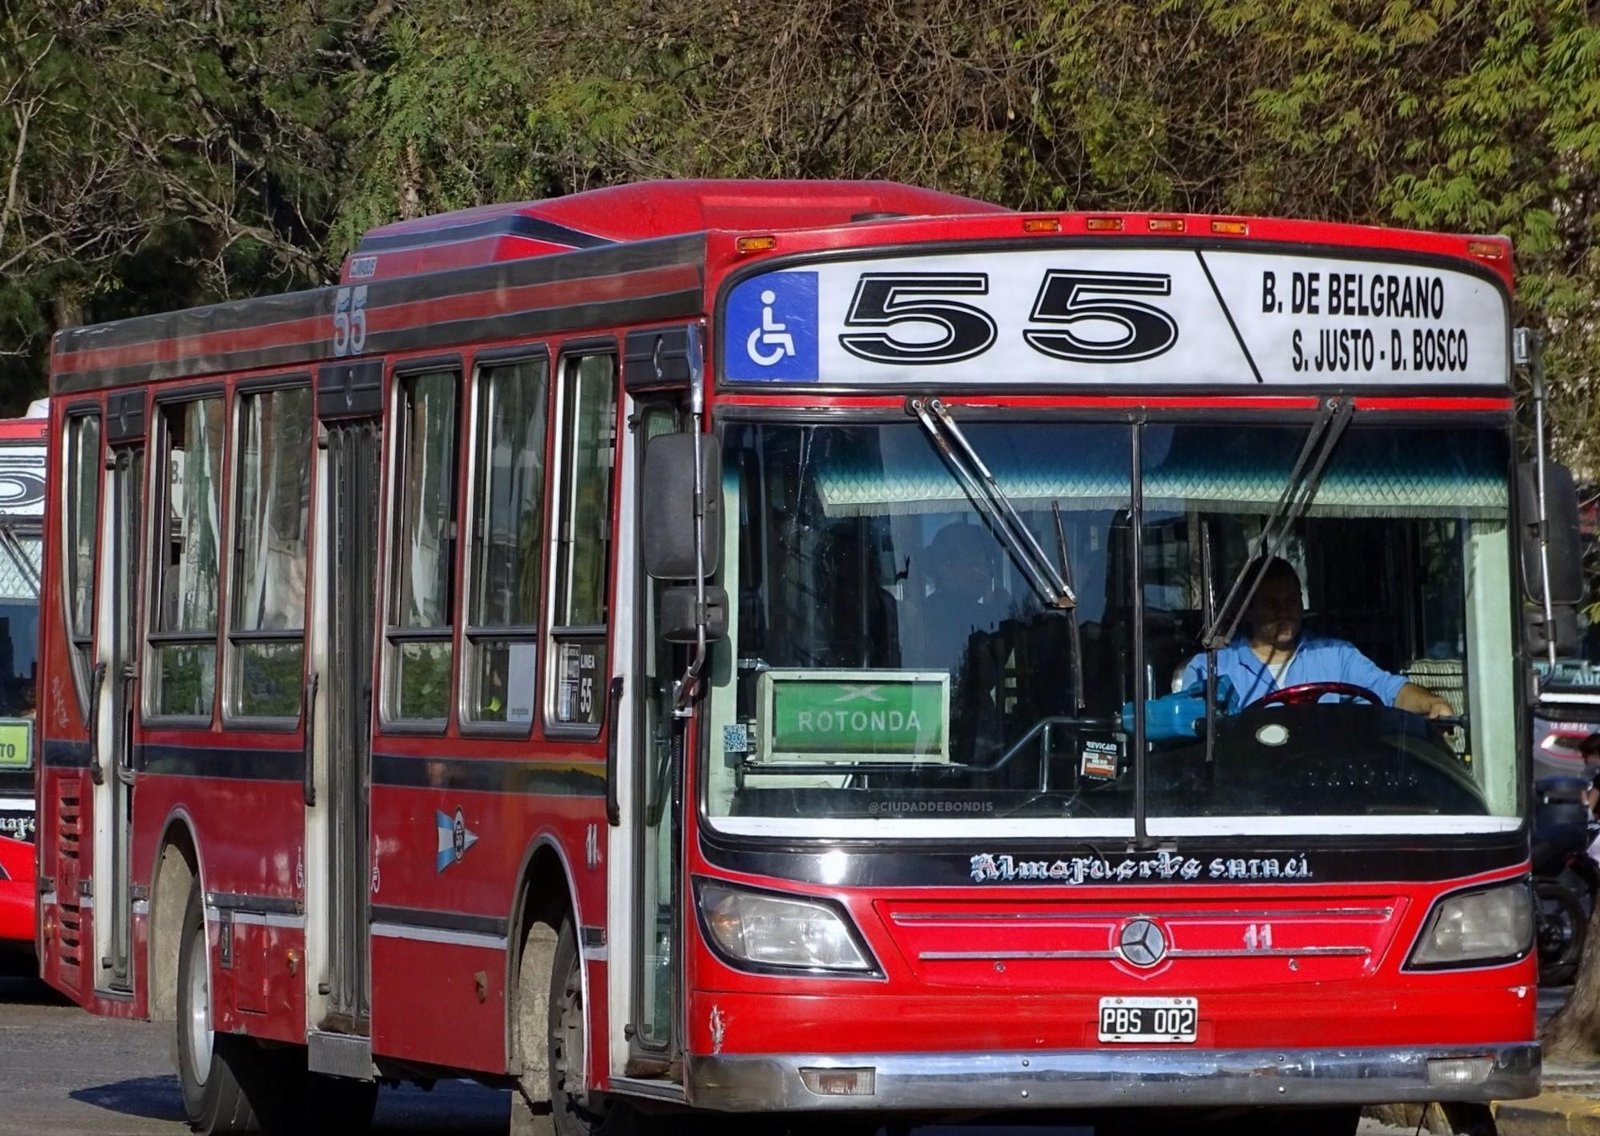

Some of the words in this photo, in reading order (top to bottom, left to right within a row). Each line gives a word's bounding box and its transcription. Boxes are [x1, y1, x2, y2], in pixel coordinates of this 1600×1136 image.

[1262, 271, 1282, 313] B.
[1292, 272, 1320, 314] DE
[1328, 273, 1444, 319] BELGRANO
[334, 285, 368, 357] 55
[838, 268, 1179, 365] 55
[1292, 328, 1308, 371] S.
[1315, 329, 1374, 372] JUSTO
[1391, 329, 1407, 371] D.
[1413, 329, 1468, 371] BOSCO
[580, 678, 592, 713] 55
[798, 710, 921, 732] ROTONDA
[586, 824, 598, 864] 11
[969, 851, 1202, 885] Almafuerte
[1242, 923, 1273, 950] 11
[1103, 1009, 1142, 1033] PBS
[1154, 1009, 1193, 1033] 002
